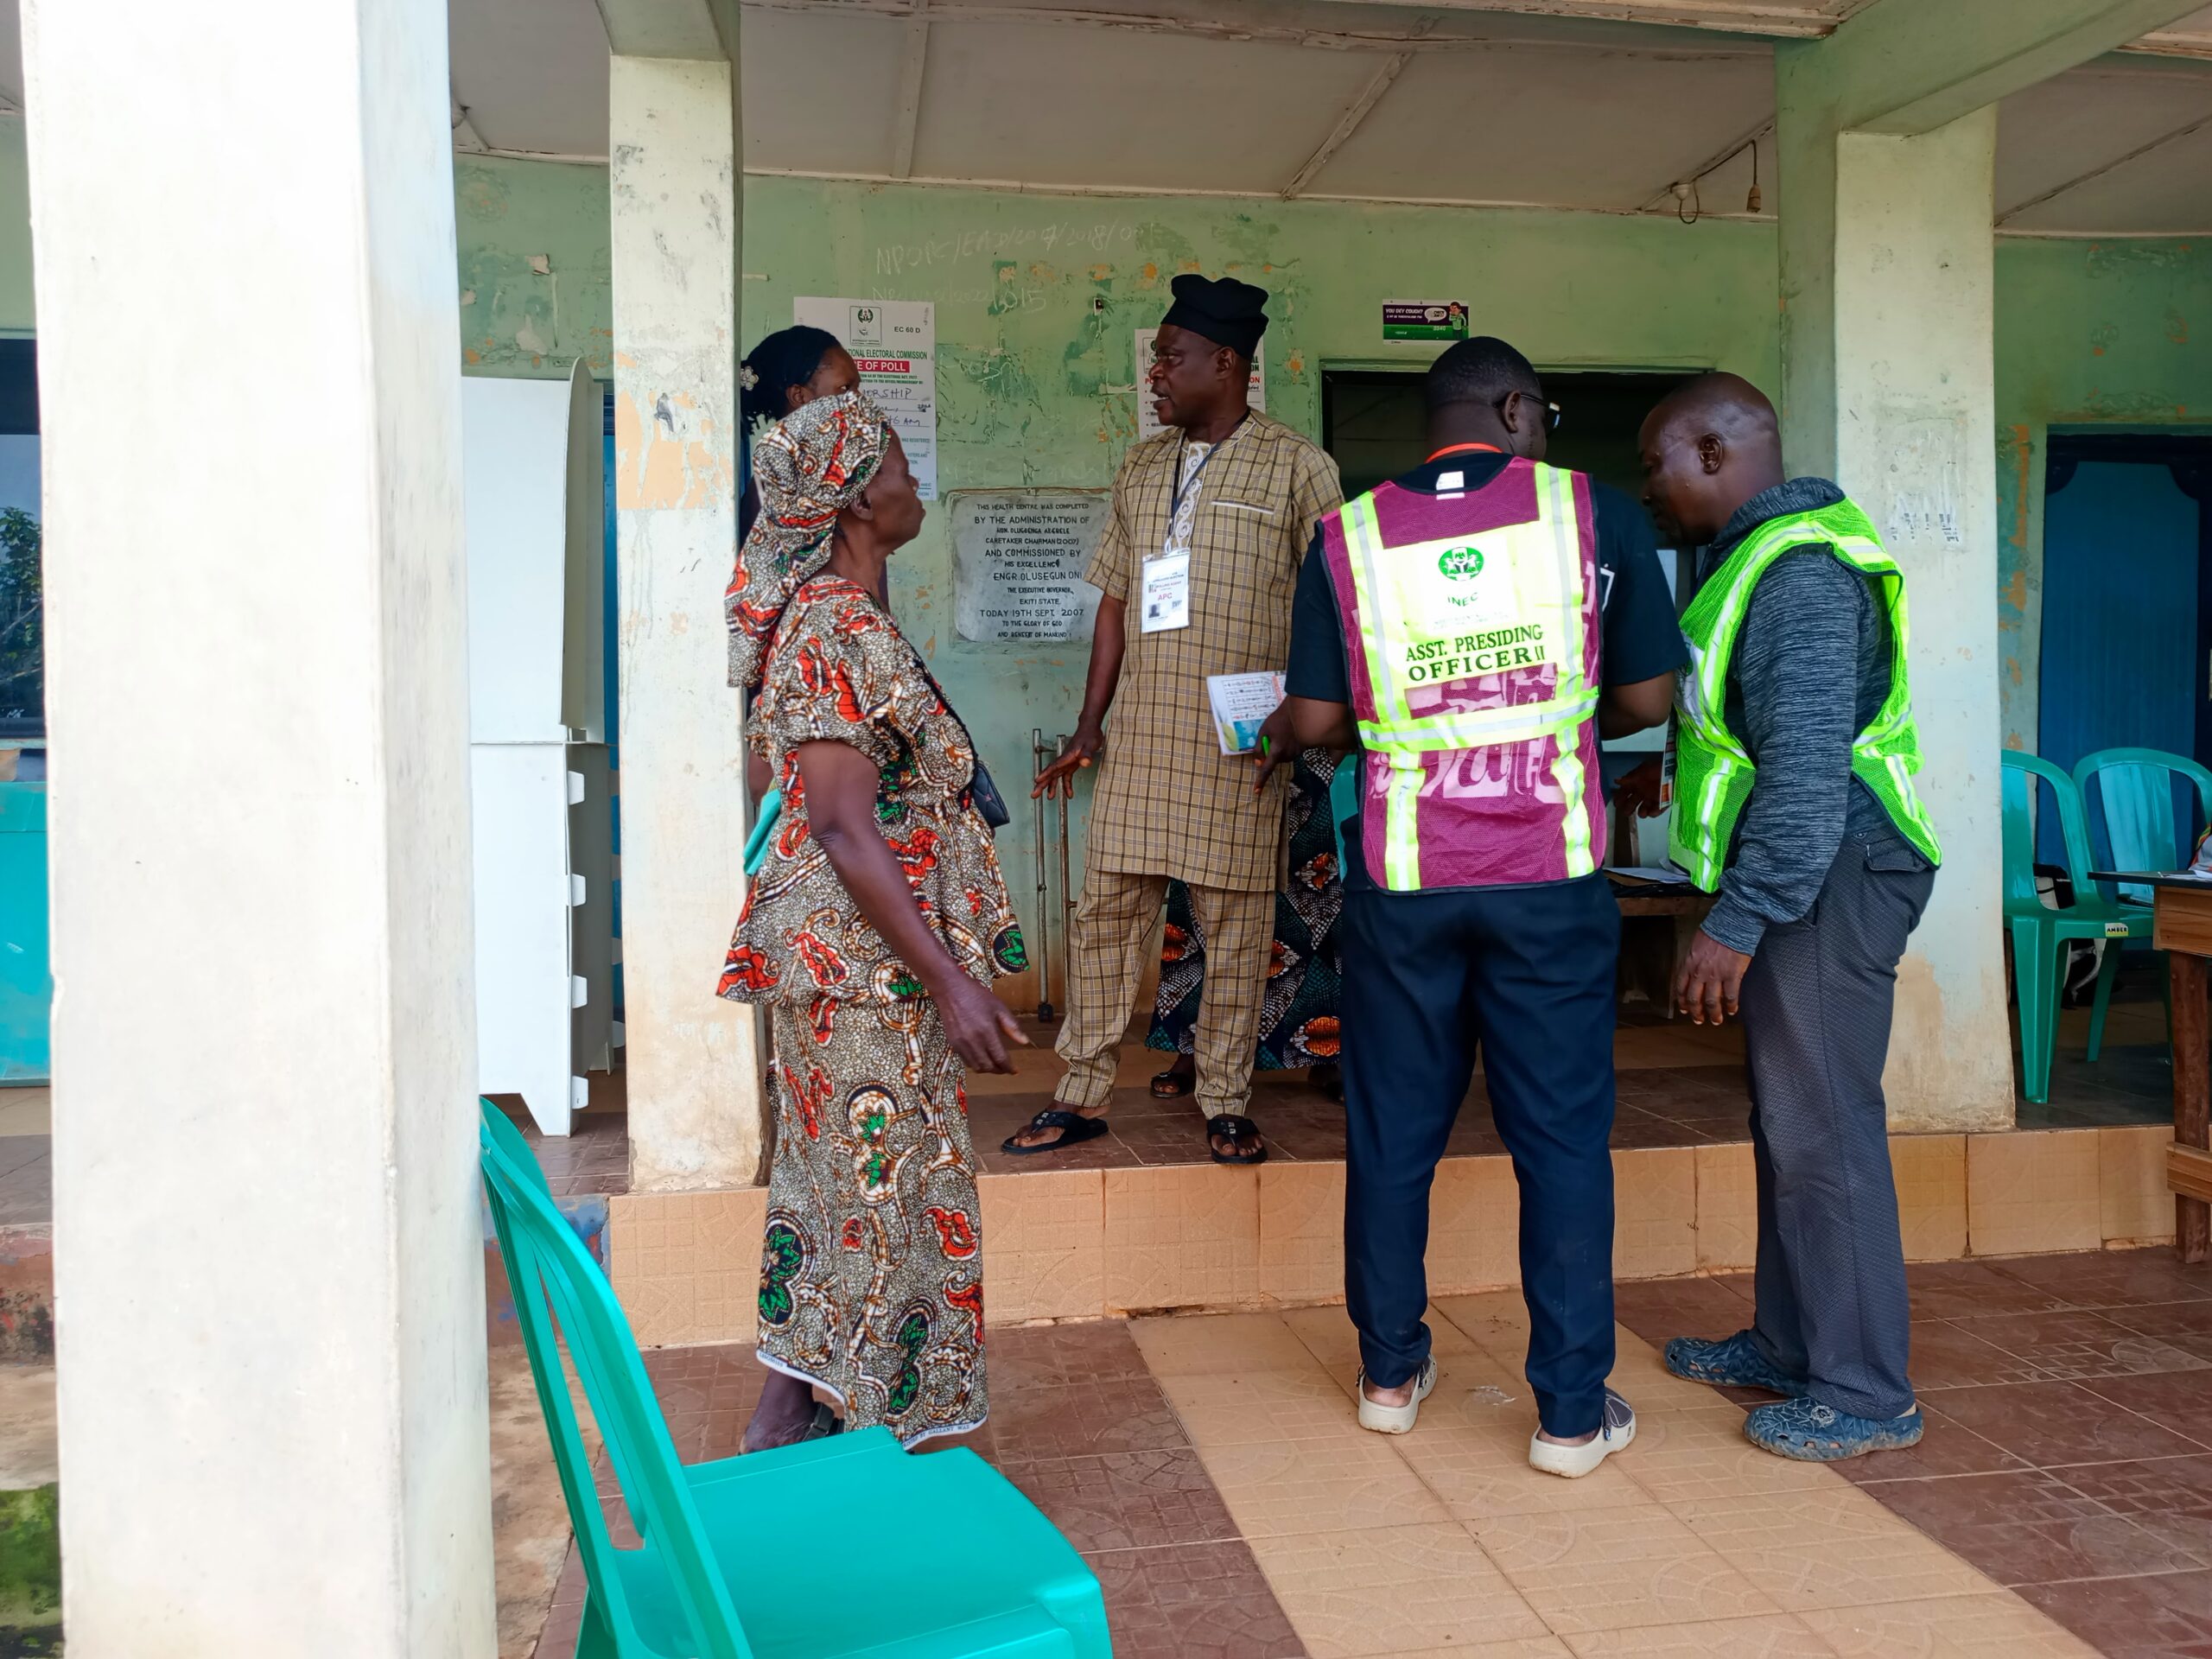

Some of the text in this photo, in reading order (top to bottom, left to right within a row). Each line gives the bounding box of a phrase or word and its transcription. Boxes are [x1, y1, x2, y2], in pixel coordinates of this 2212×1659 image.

[866, 349, 895, 359] ELECTORAL
[897, 350, 928, 359] COMMISSION
[865, 361, 879, 371] OF
[881, 361, 906, 372] POLL
[1005, 549, 1065, 557] COMMISSIONED
[1447, 592, 1478, 607] INEC
[1406, 625, 1543, 662] ASST. PRESIDING
[1408, 647, 1532, 681] OFFICER
